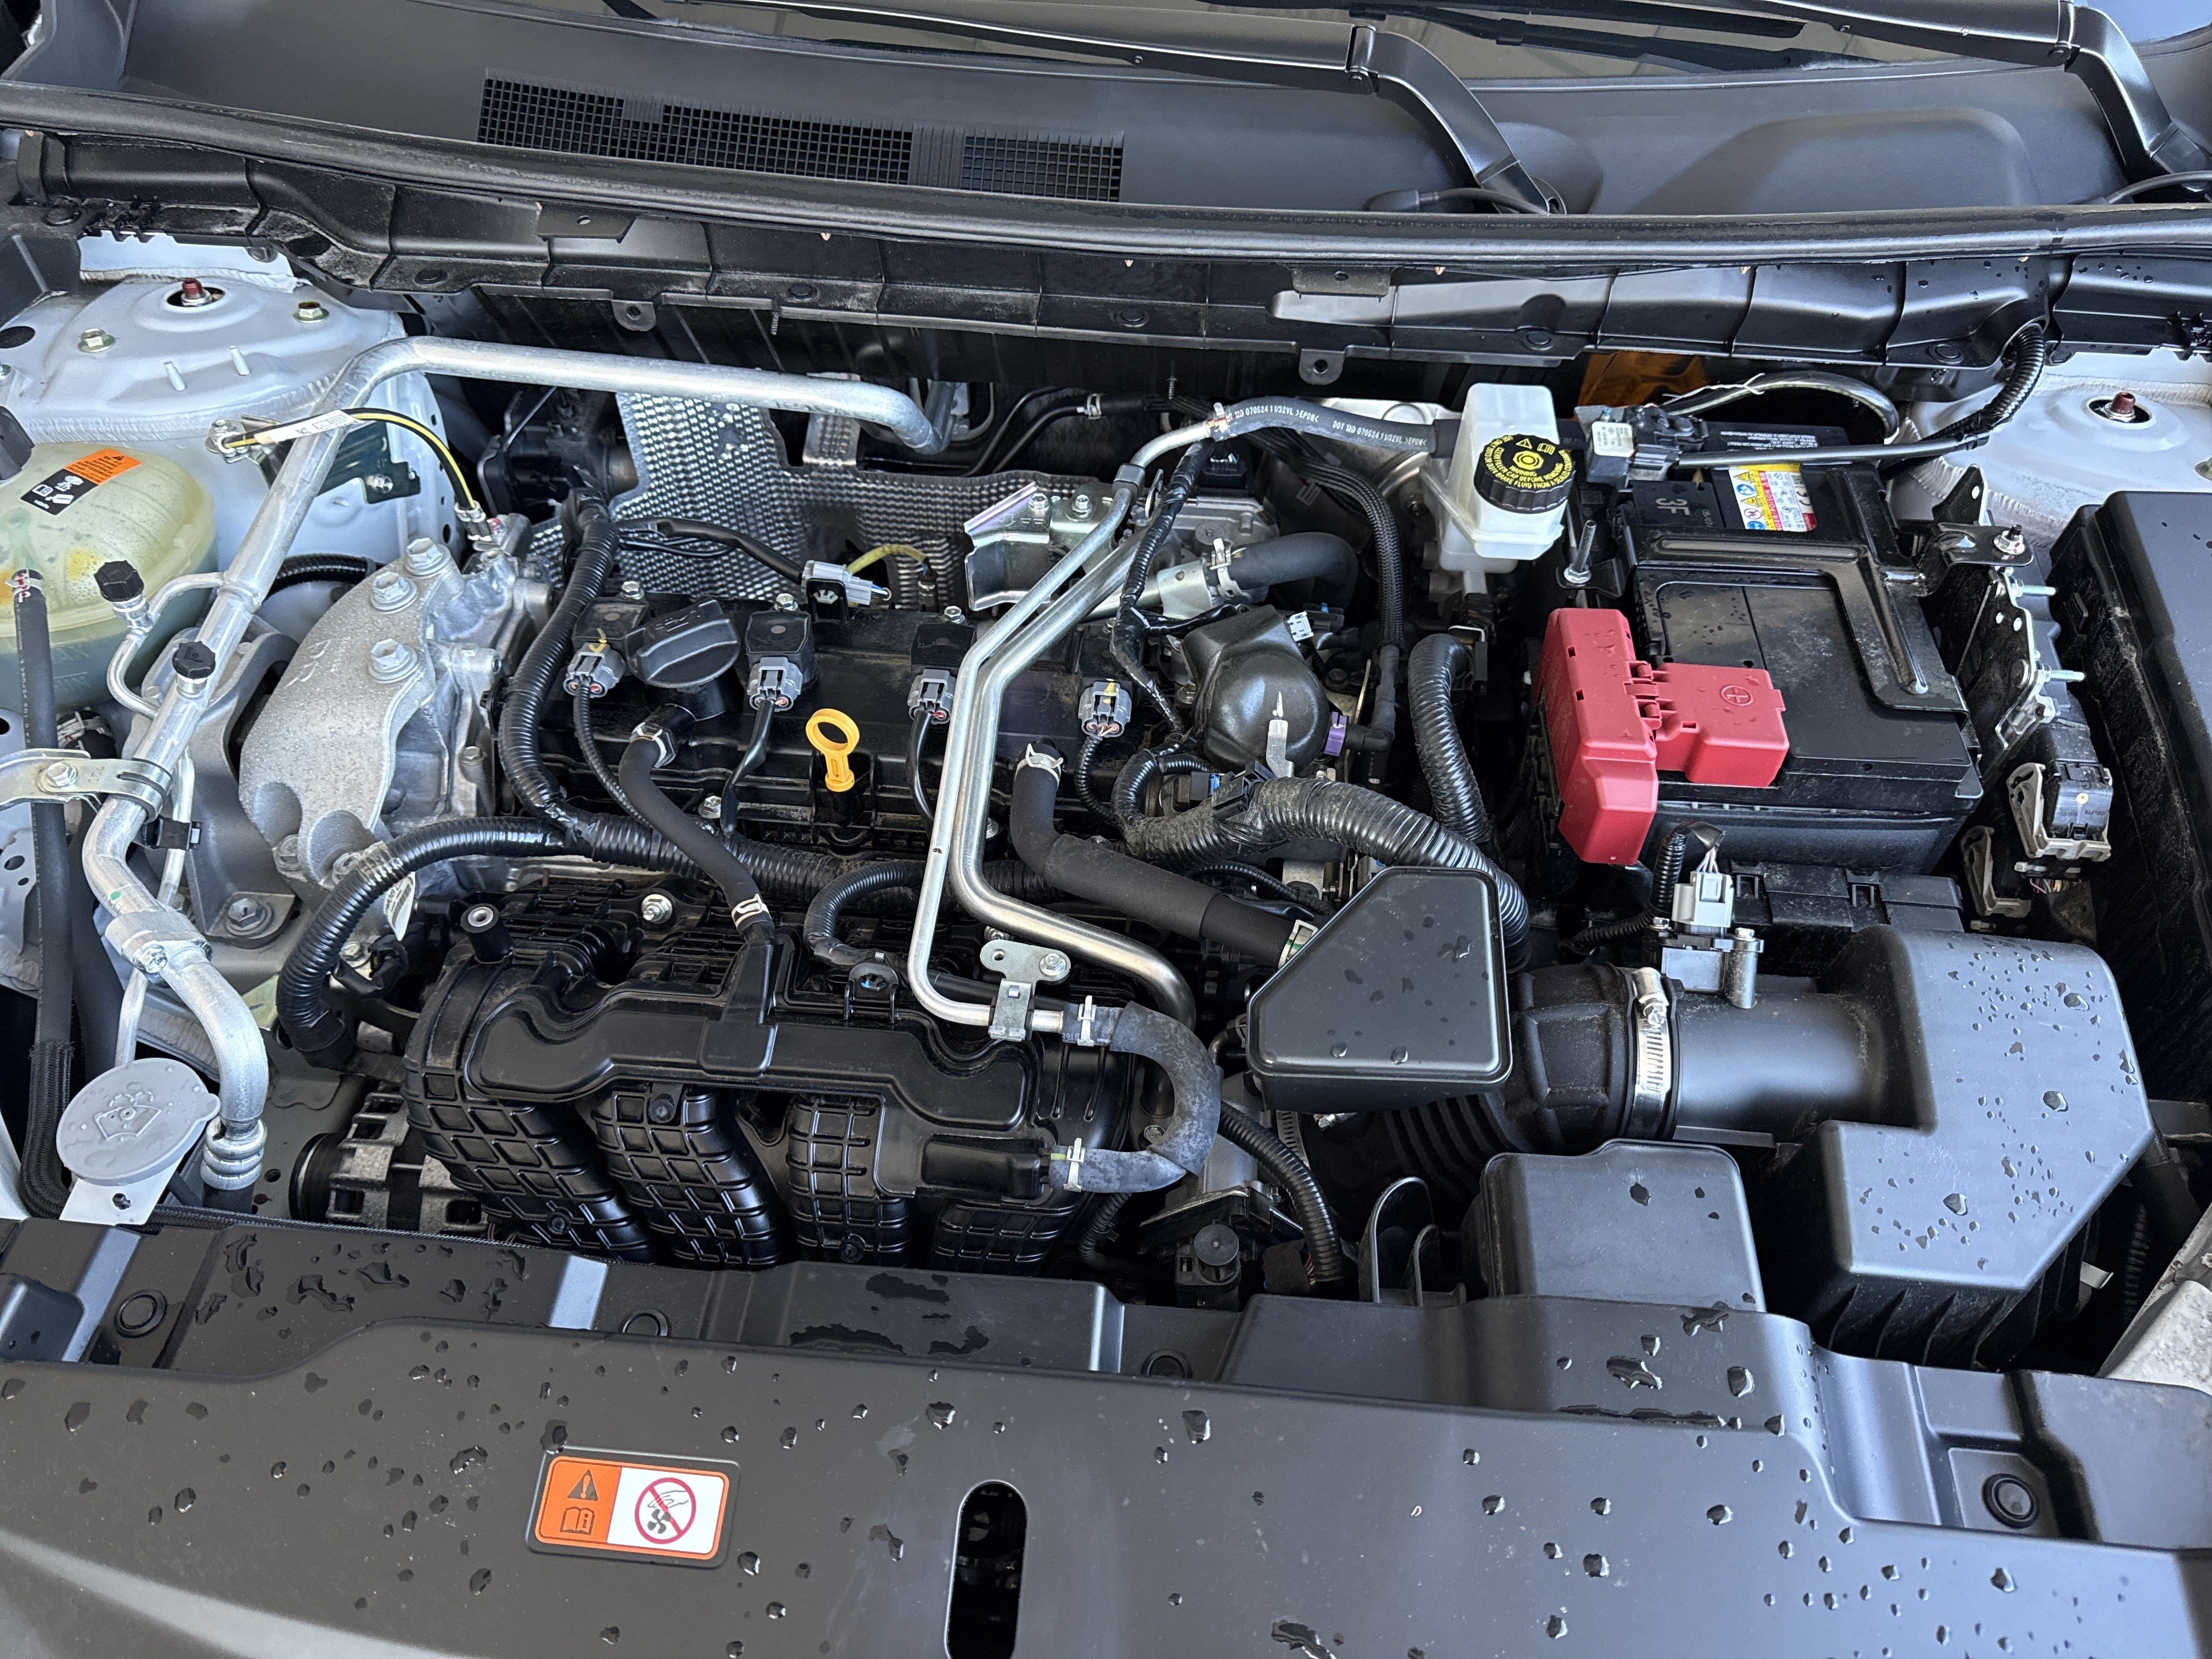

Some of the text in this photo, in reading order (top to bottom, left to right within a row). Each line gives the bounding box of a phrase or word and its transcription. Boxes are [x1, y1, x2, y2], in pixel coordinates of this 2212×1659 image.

[1245, 405, 1268, 416] 070524
[1332, 420, 1345, 431] DOT
[1357, 427, 1380, 439] 070524
[1489, 439, 1504, 449] ONLY
[1558, 449, 1572, 472] CONTAINER
[1493, 459, 1509, 473] FILLER
[1505, 471, 1519, 479] CAP
[1543, 462, 1564, 481] REMOVING
[1509, 465, 1537, 477] WARNING
[1495, 472, 1514, 485] BRAKE
[1554, 471, 1571, 484] SEALED
[1514, 480, 1533, 489] FLUID
[1655, 498, 1690, 516] 3F
